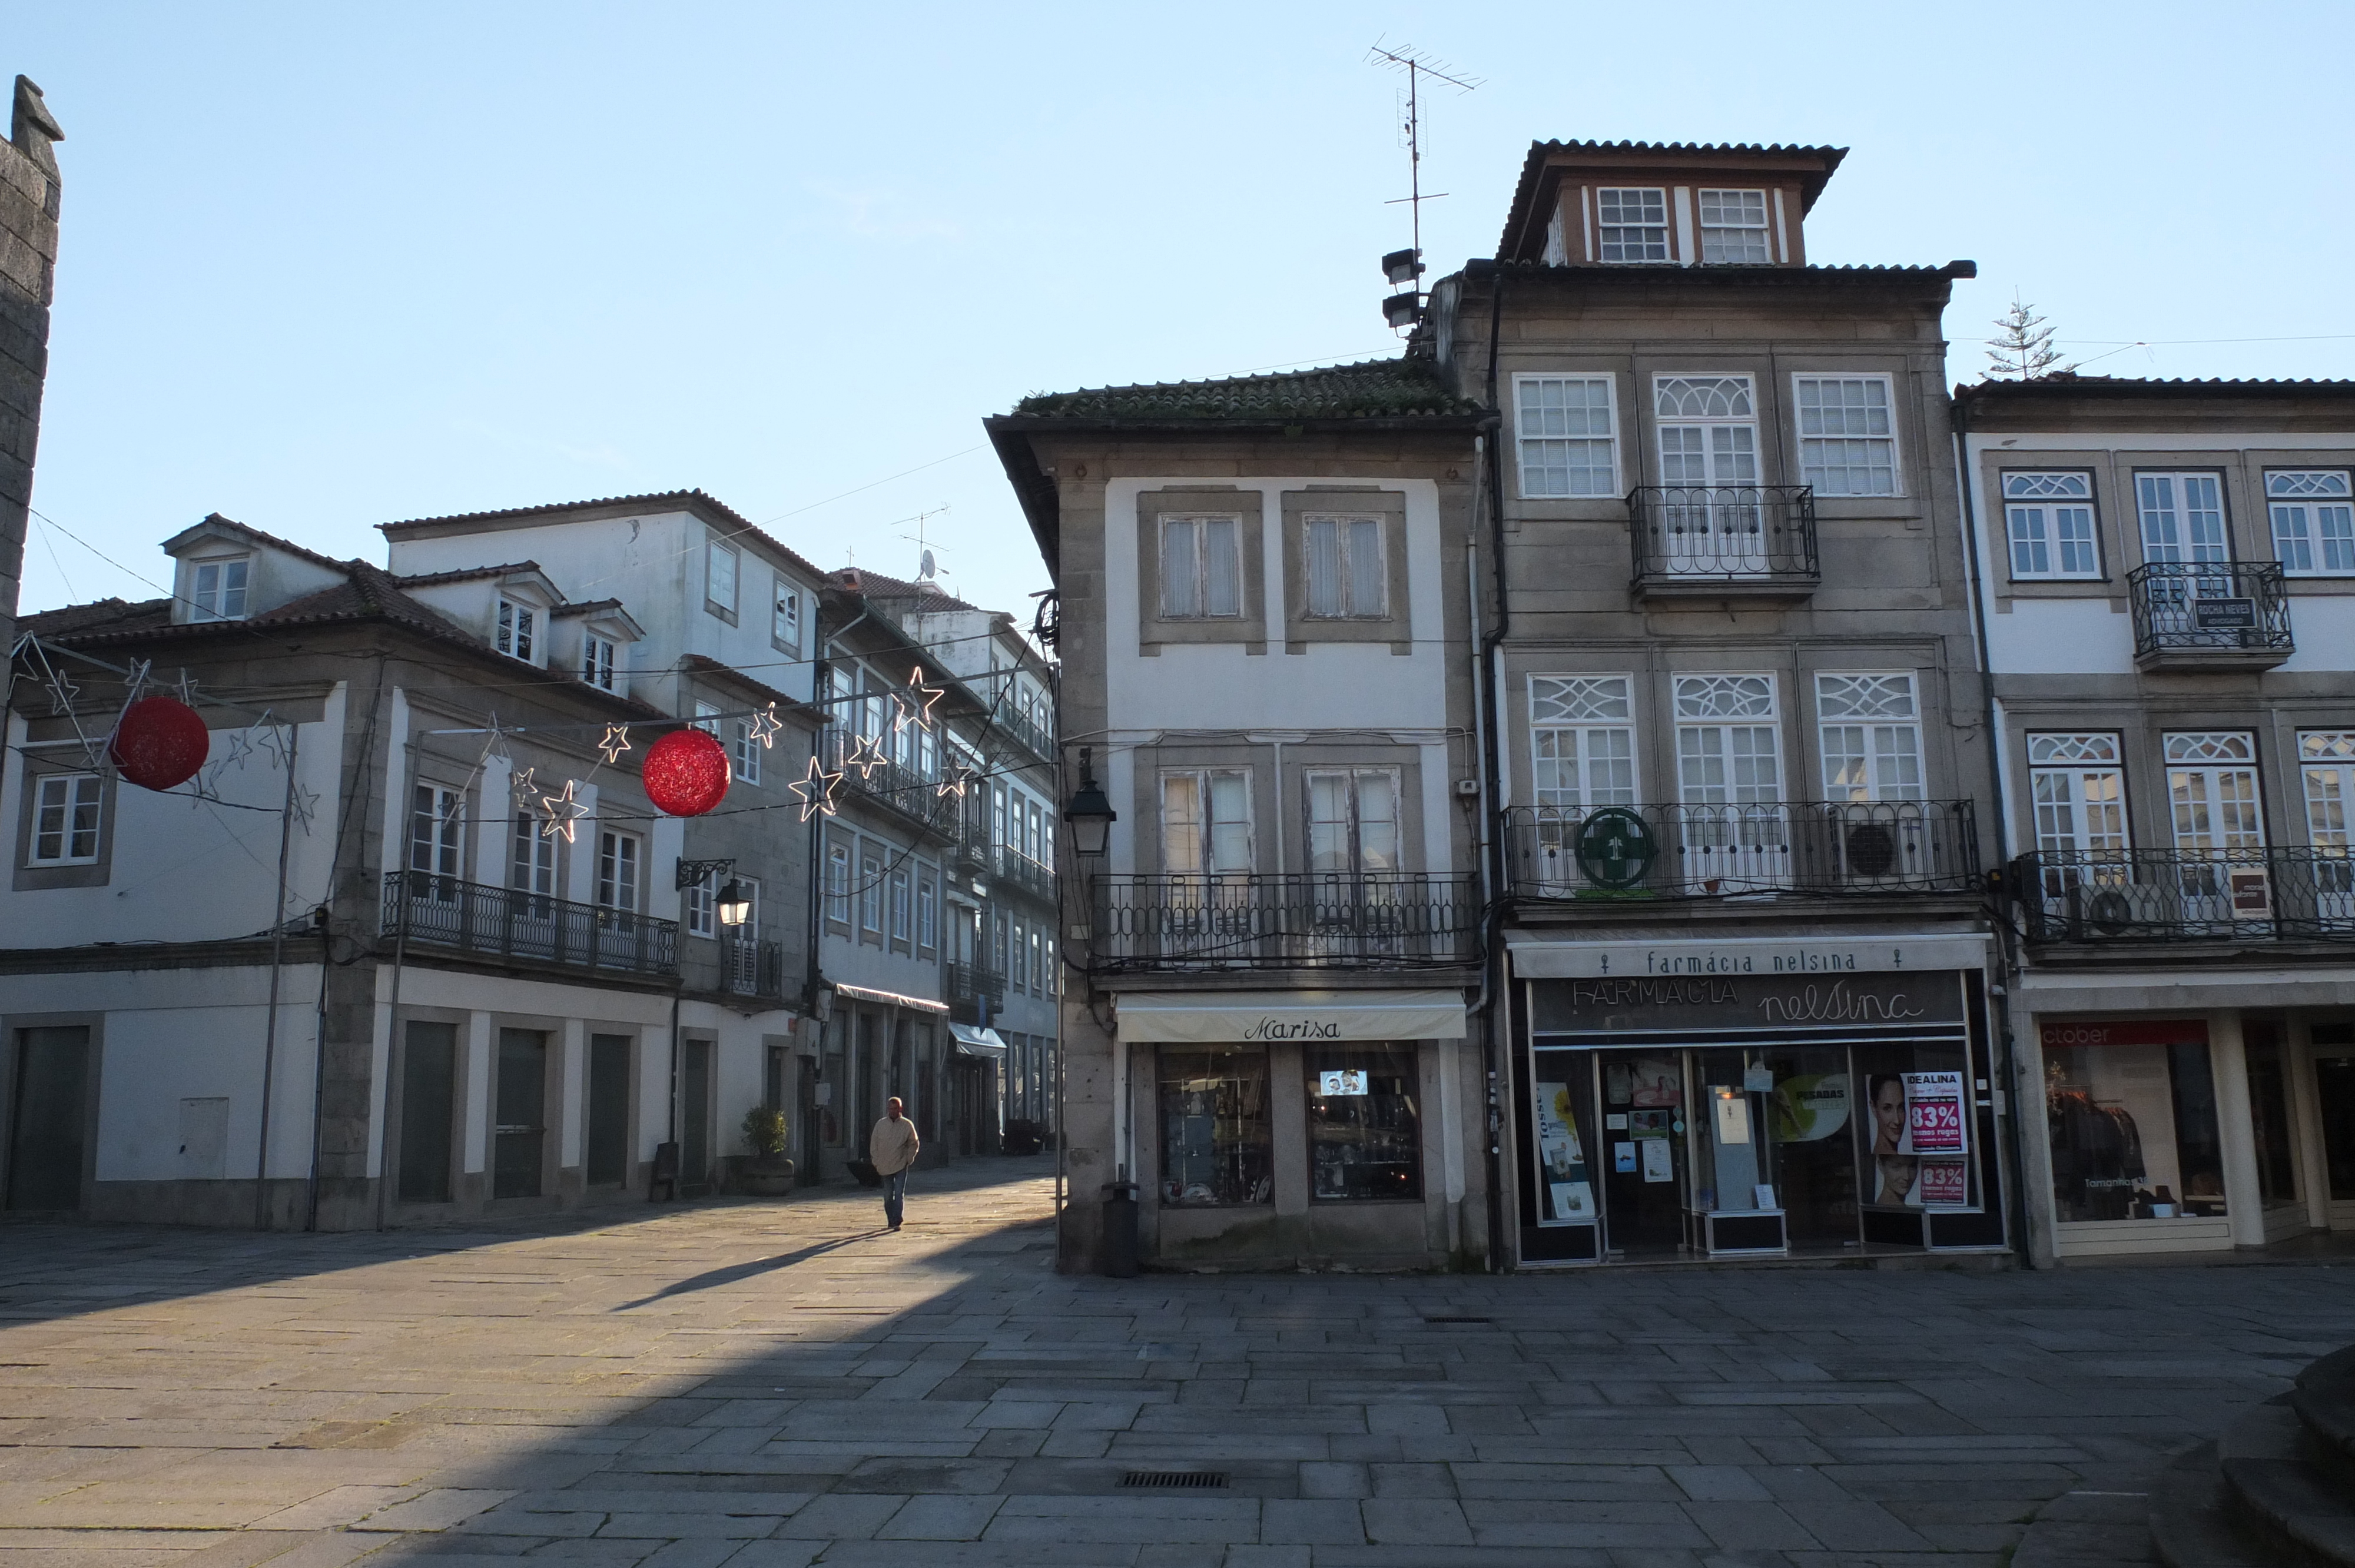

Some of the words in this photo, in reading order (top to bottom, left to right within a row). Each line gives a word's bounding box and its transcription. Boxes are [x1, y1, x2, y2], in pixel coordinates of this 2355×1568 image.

[2198, 604, 2224, 614] ROCHA
[1648, 951, 1753, 973] farmácia
[1773, 950, 1856, 971] nelsina
[1244, 1016, 1341, 1040] Marisa
[1907, 1075, 1957, 1084] IDEALINA
[1911, 1105, 1959, 1128] 83%
[1937, 1129, 1959, 1138] rugas
[1923, 1168, 1963, 1185] 83%
